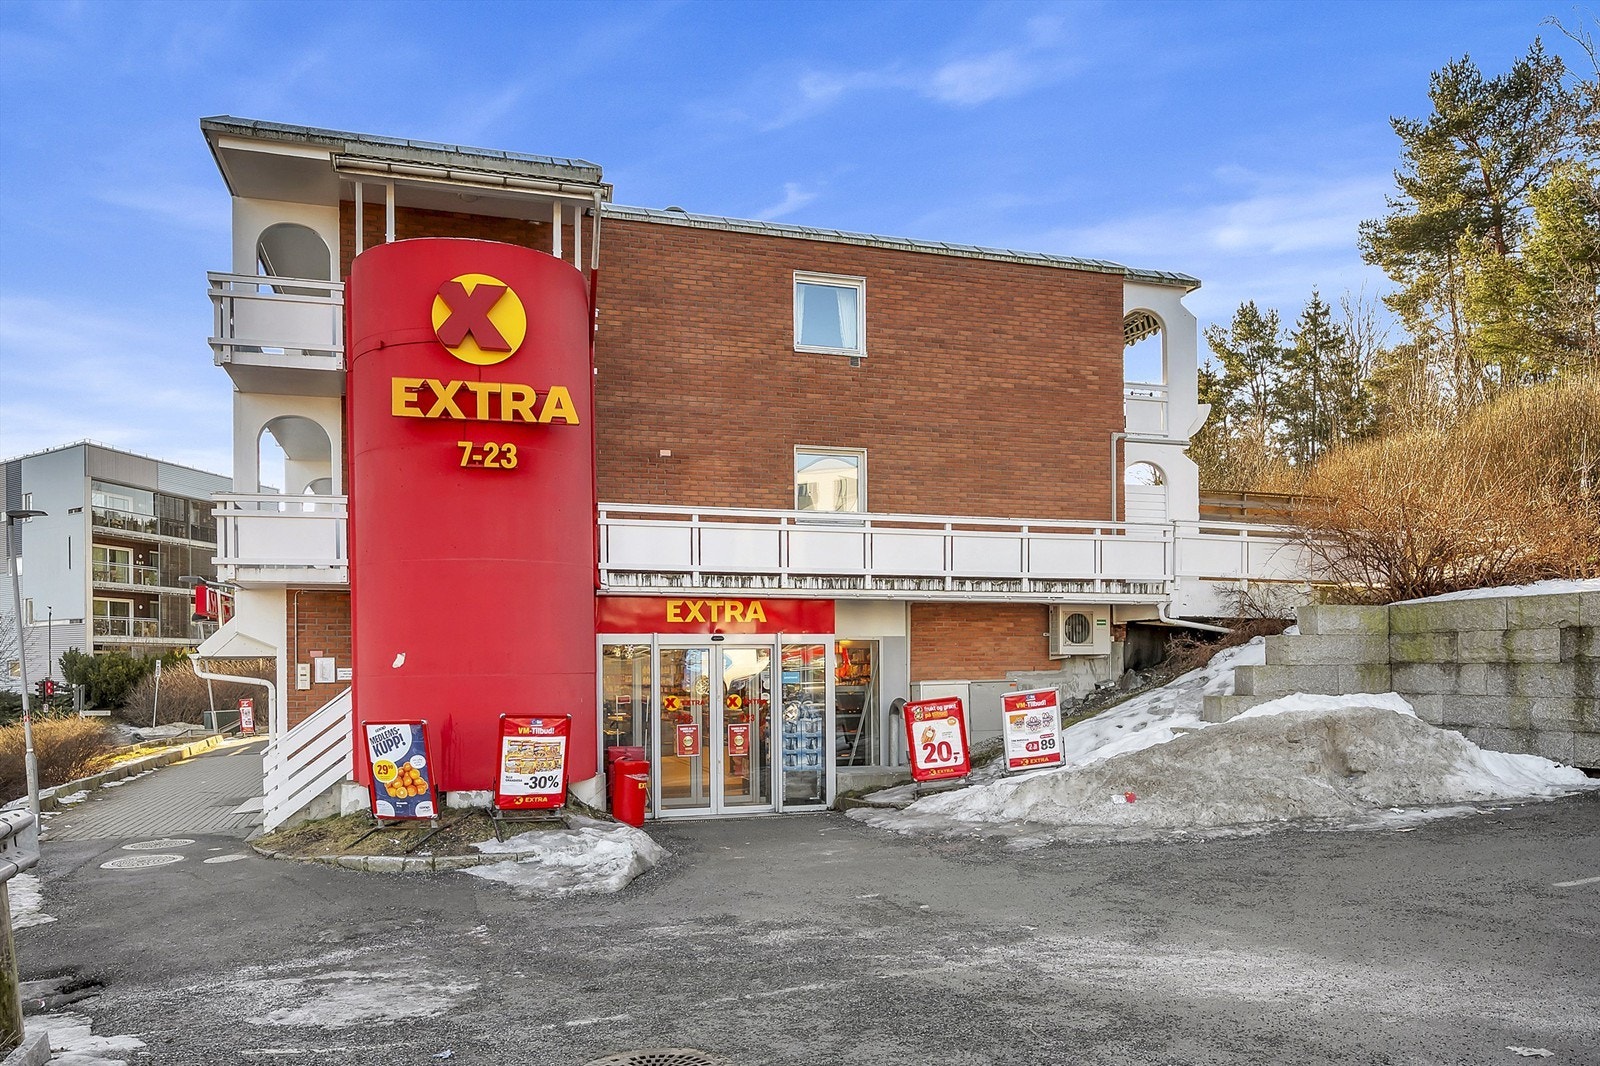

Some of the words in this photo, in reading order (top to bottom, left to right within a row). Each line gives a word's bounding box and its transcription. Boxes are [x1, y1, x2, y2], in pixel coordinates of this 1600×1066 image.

[391, 376, 580, 425] EXTRA
[457, 441, 518, 469] 7-23
[666, 600, 767, 623] EXTRA
[372, 733, 406, 758] KUPP!
[1041, 738, 1056, 750] 89
[524, 775, 559, 789] -30%
